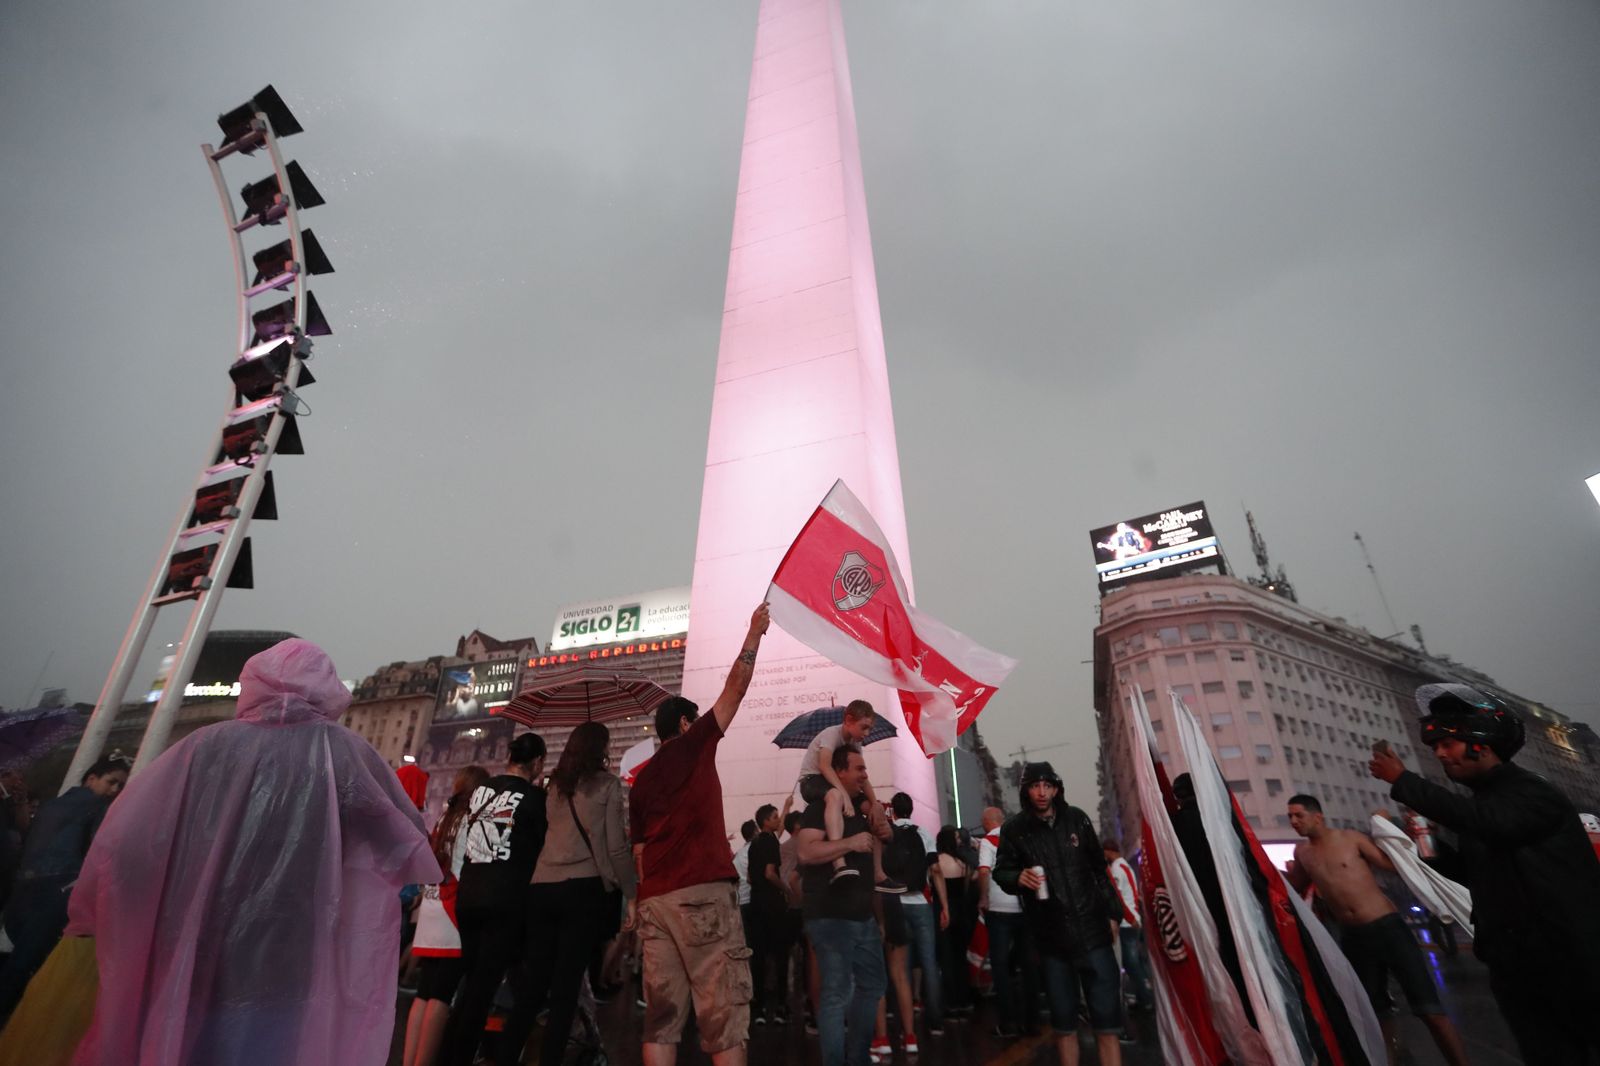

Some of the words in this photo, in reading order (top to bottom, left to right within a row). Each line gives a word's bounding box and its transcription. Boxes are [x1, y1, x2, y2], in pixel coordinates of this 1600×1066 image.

[563, 604, 614, 619] UNIVERSIDAD
[648, 608, 657, 616] La
[560, 615, 613, 637] SIGLO
[618, 611, 637, 630] 21
[528, 654, 580, 667] HOTEL
[474, 683, 495, 696] BIRD
[497, 682, 513, 693] BOX
[742, 697, 773, 709] PEDRO
[777, 695, 790, 706] DE
[793, 691, 838, 705] MENDOZA
